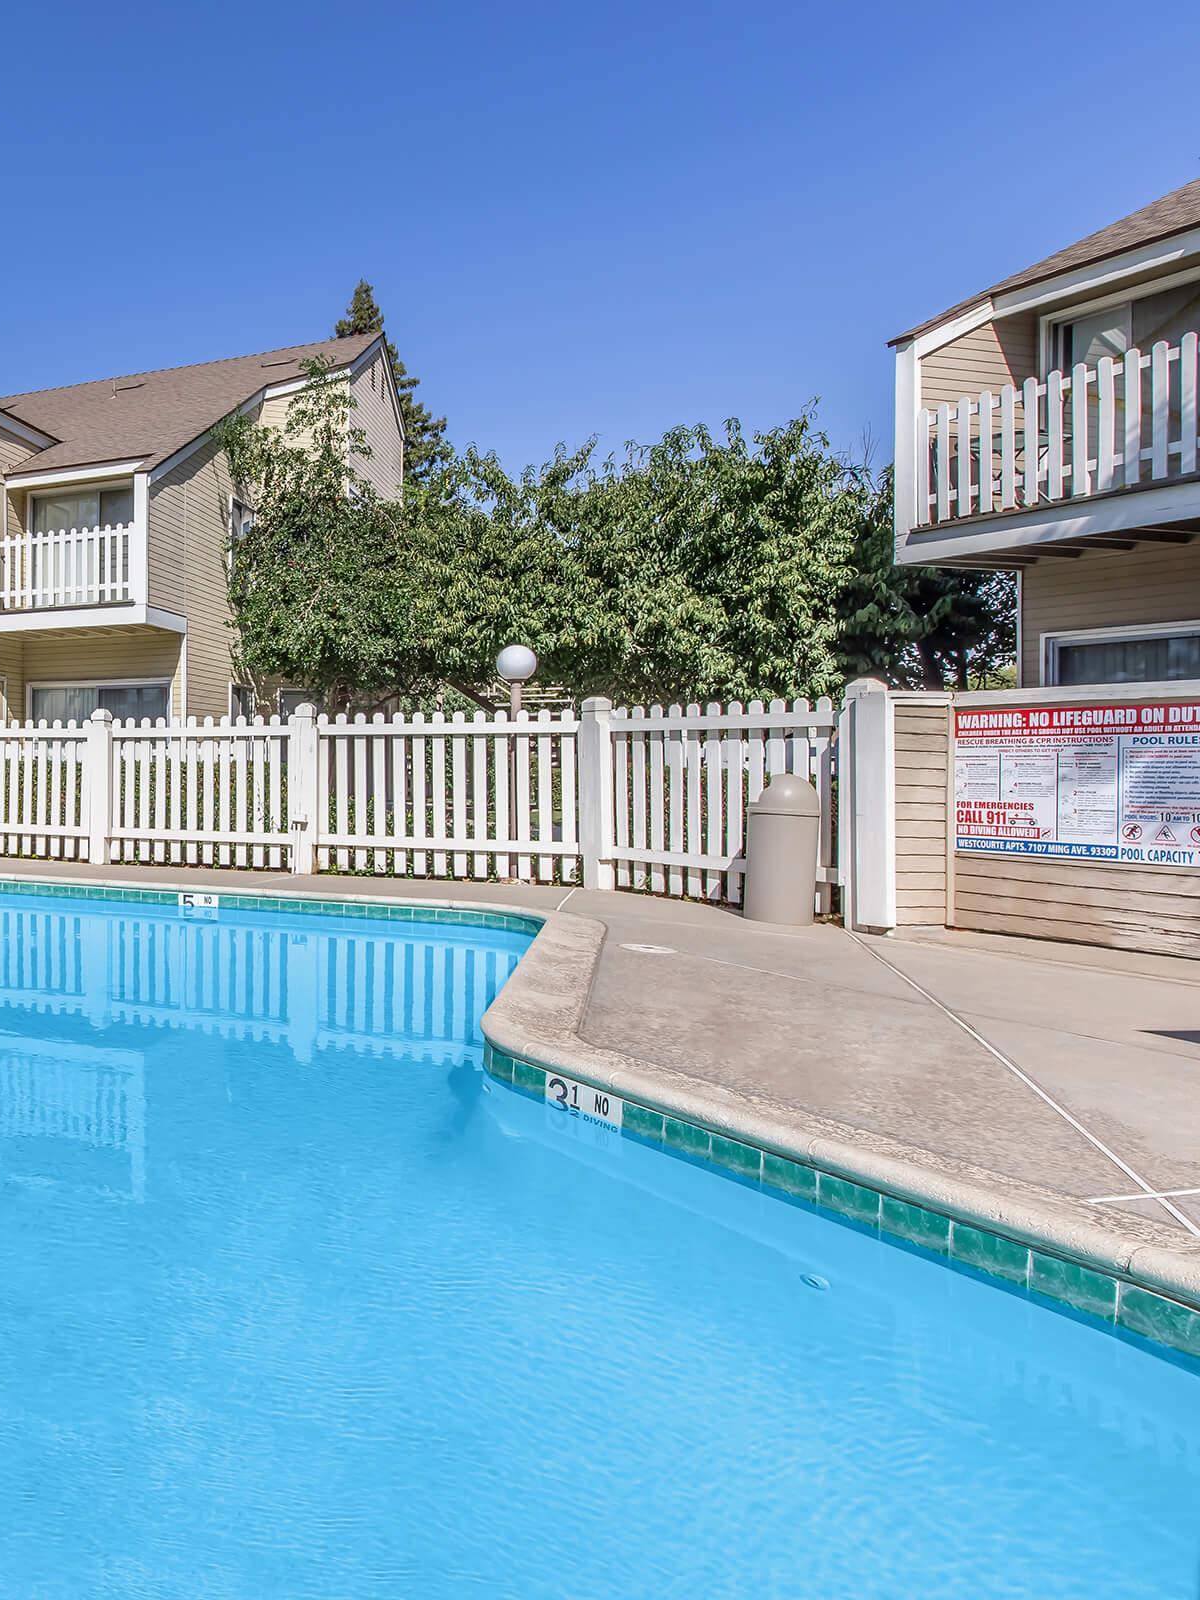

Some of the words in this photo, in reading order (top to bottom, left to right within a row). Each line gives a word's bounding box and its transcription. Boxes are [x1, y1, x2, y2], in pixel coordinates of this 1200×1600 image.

[957, 713, 1026, 729] WARNING:
[1029, 712, 1049, 727] NO
[1053, 709, 1137, 726] LIFEGUARD
[1141, 707, 1164, 724] ON
[1165, 724, 1172, 732] IN
[957, 738, 984, 746] RESCUE
[985, 737, 1028, 745] BREATHING
[1053, 736, 1114, 744] INSTRUCTIONS
[1132, 736, 1165, 746] POOL
[1167, 735, 1200, 745] RULE
[956, 801, 972, 809] FOR
[974, 802, 1034, 811] EMERGENCIES
[956, 809, 984, 824] CALL
[986, 811, 1007, 825] 911
[1160, 813, 1171, 823] 10
[957, 825, 969, 834] NO
[970, 826, 997, 836] DIVING
[997, 827, 1039, 838] ALLOWED!
[958, 839, 1005, 850] WESTCOURTE
[1005, 841, 1027, 852] APTS.
[1028, 843, 1047, 853] 7107
[1048, 844, 1070, 855] MING
[1070, 845, 1090, 856] AVE.
[1090, 846, 1117, 857] 93309
[1121, 848, 1145, 861] POOL
[1147, 849, 1194, 865] CAPACITY
[203, 895, 213, 905] NO
[594, 1093, 609, 1117] NO
[583, 1114, 618, 1134] DIVING
